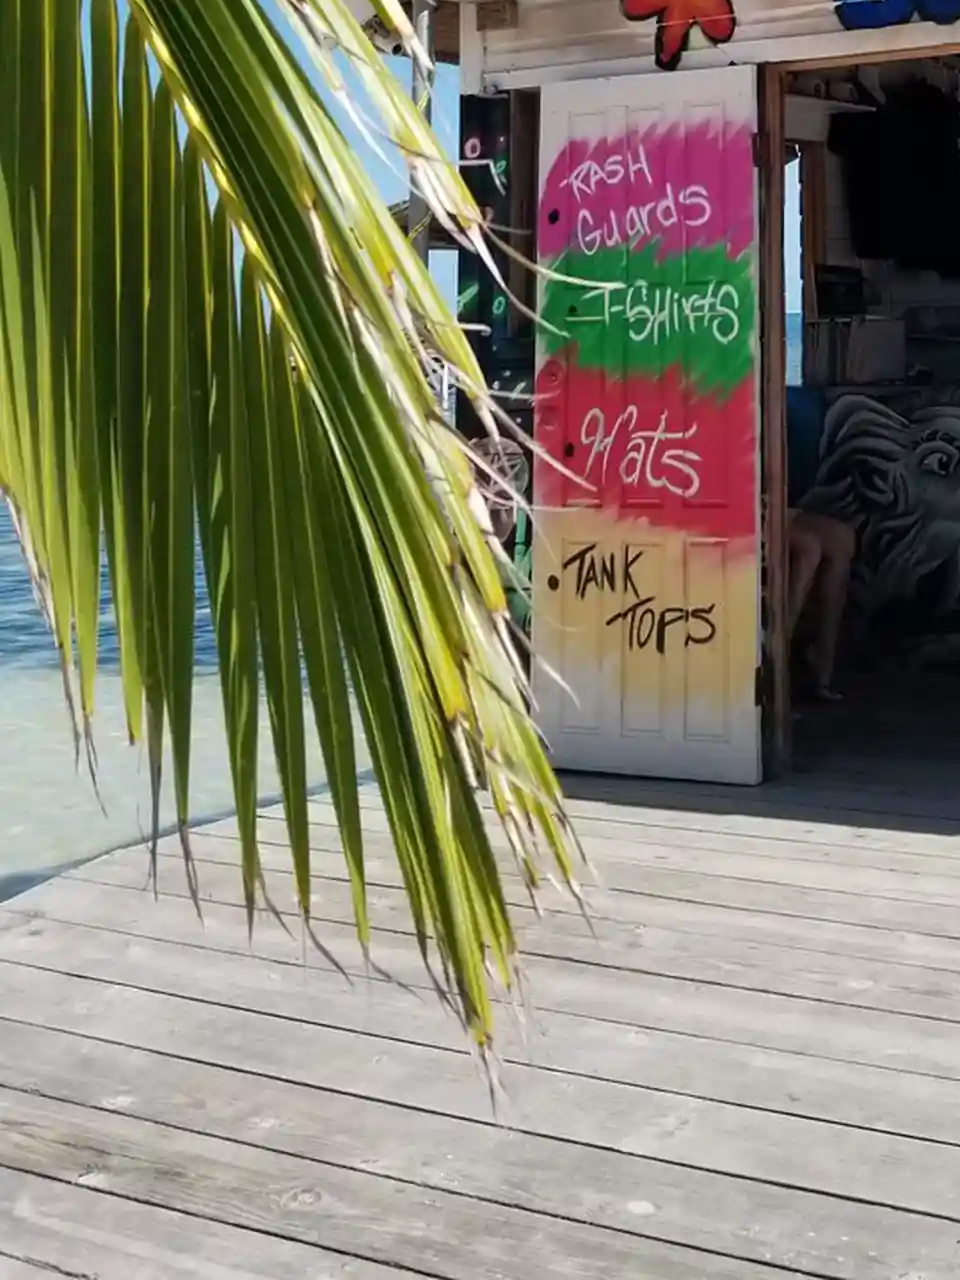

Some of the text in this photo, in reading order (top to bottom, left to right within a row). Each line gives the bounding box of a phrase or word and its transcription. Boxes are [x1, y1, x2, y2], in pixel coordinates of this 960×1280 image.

[559, 144, 653, 204] RASH
[577, 182, 711, 255] Guards
[580, 405, 702, 498] Hats
[562, 544, 643, 600] TANK
[605, 596, 716, 654] TOPS
